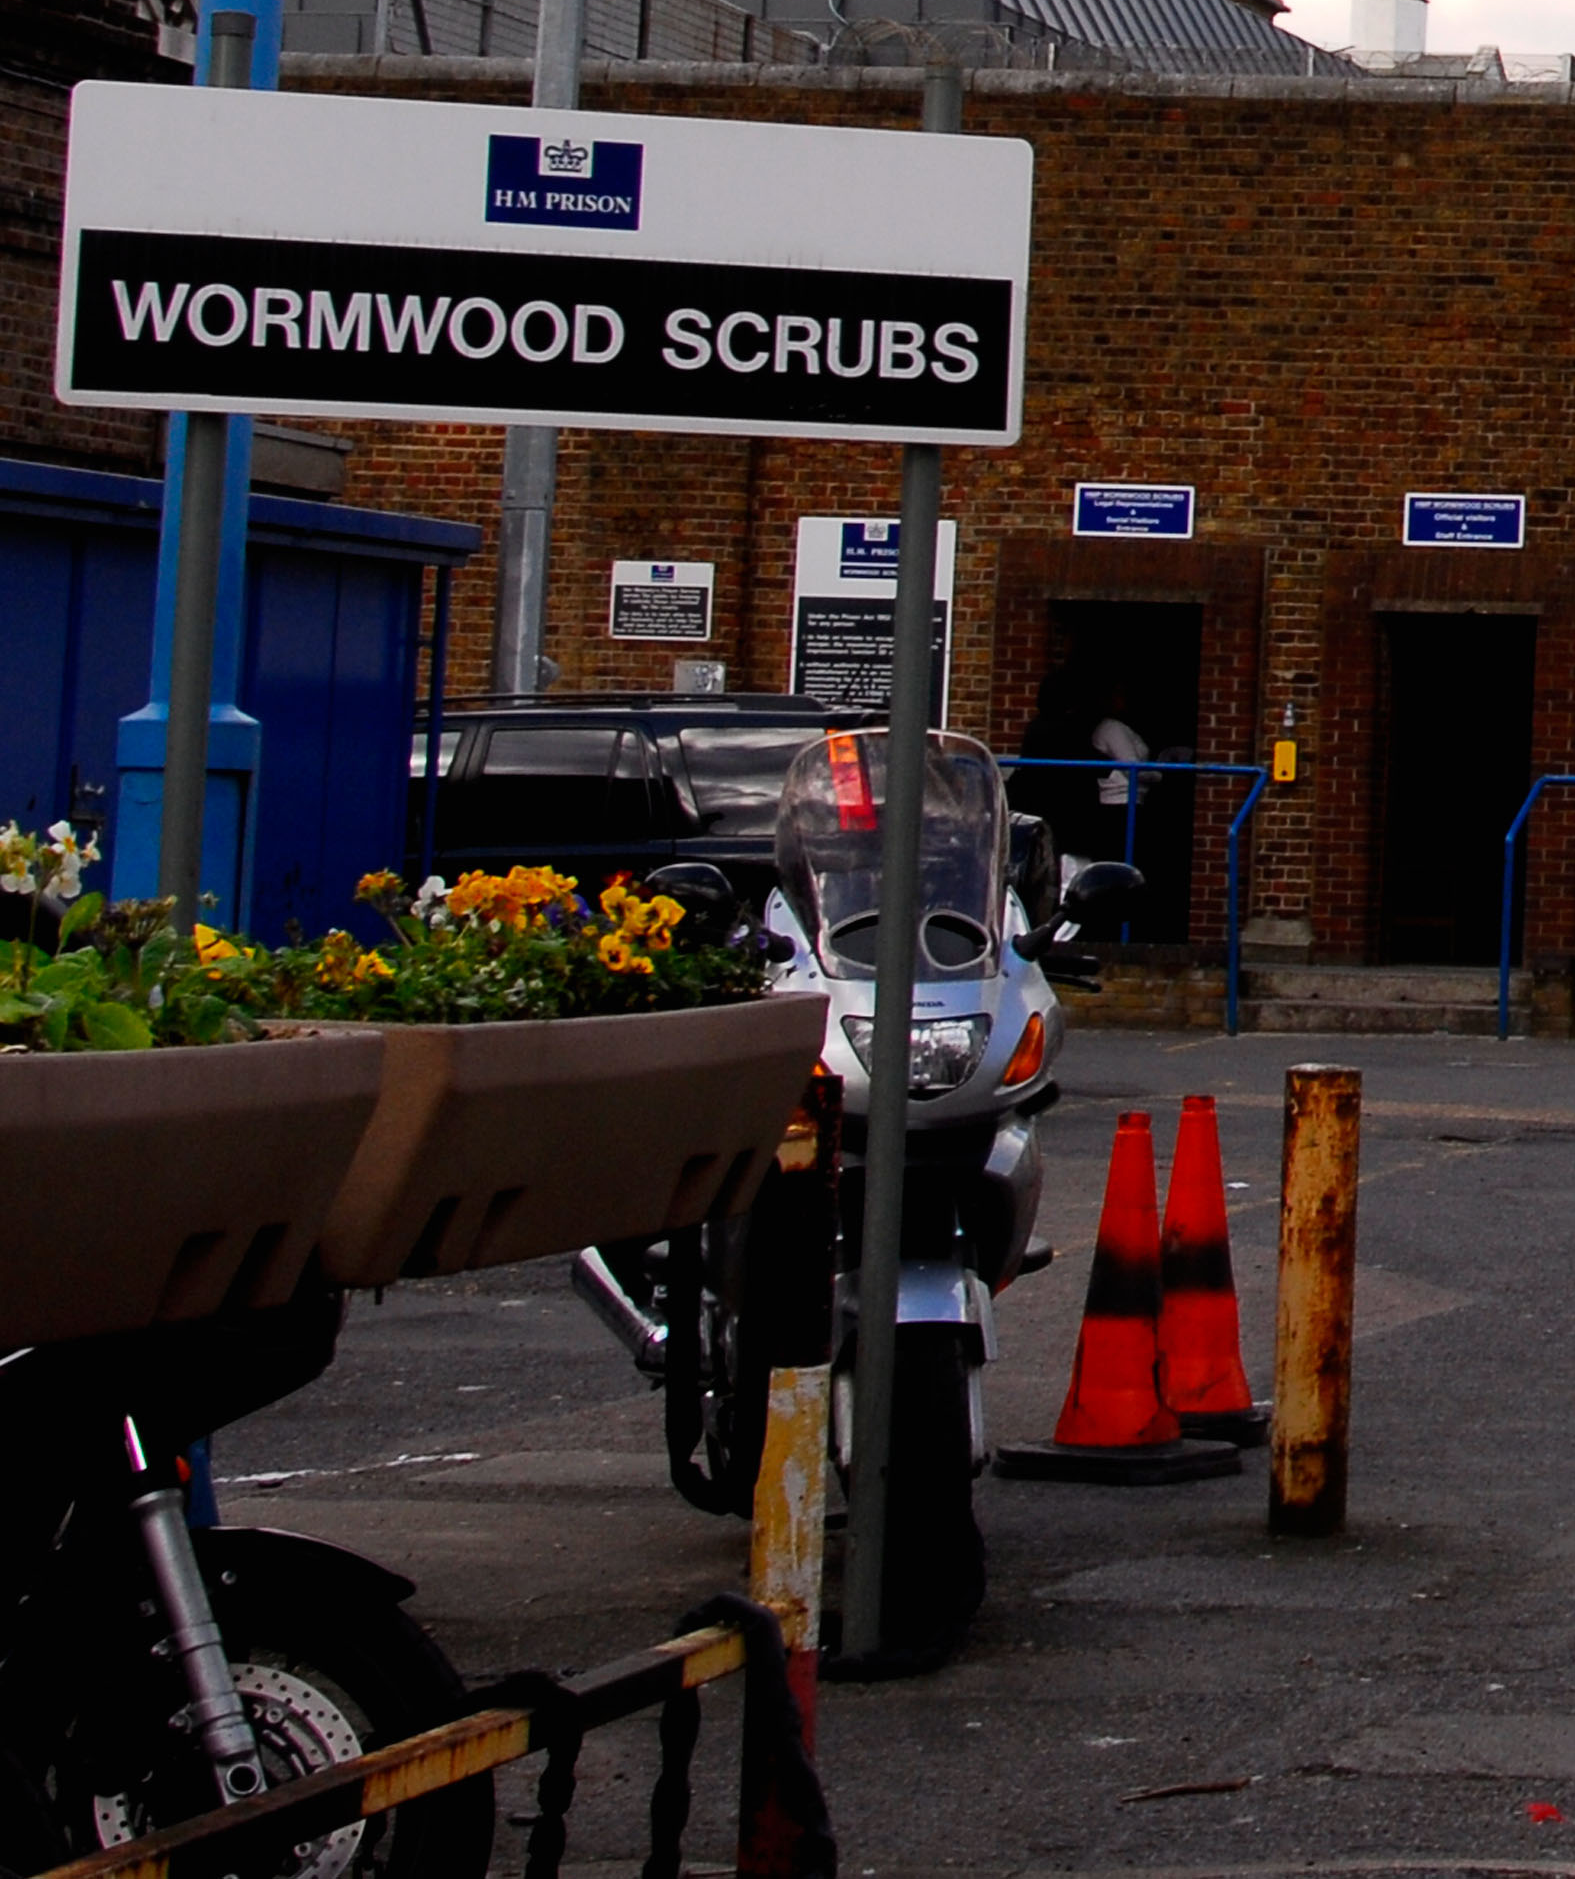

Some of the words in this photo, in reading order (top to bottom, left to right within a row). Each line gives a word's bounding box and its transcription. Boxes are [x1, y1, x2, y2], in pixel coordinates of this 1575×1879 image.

[545, 191, 633, 214] PRISON
[112, 278, 625, 365] WORMWOOD
[661, 308, 980, 384] SCRUBS
